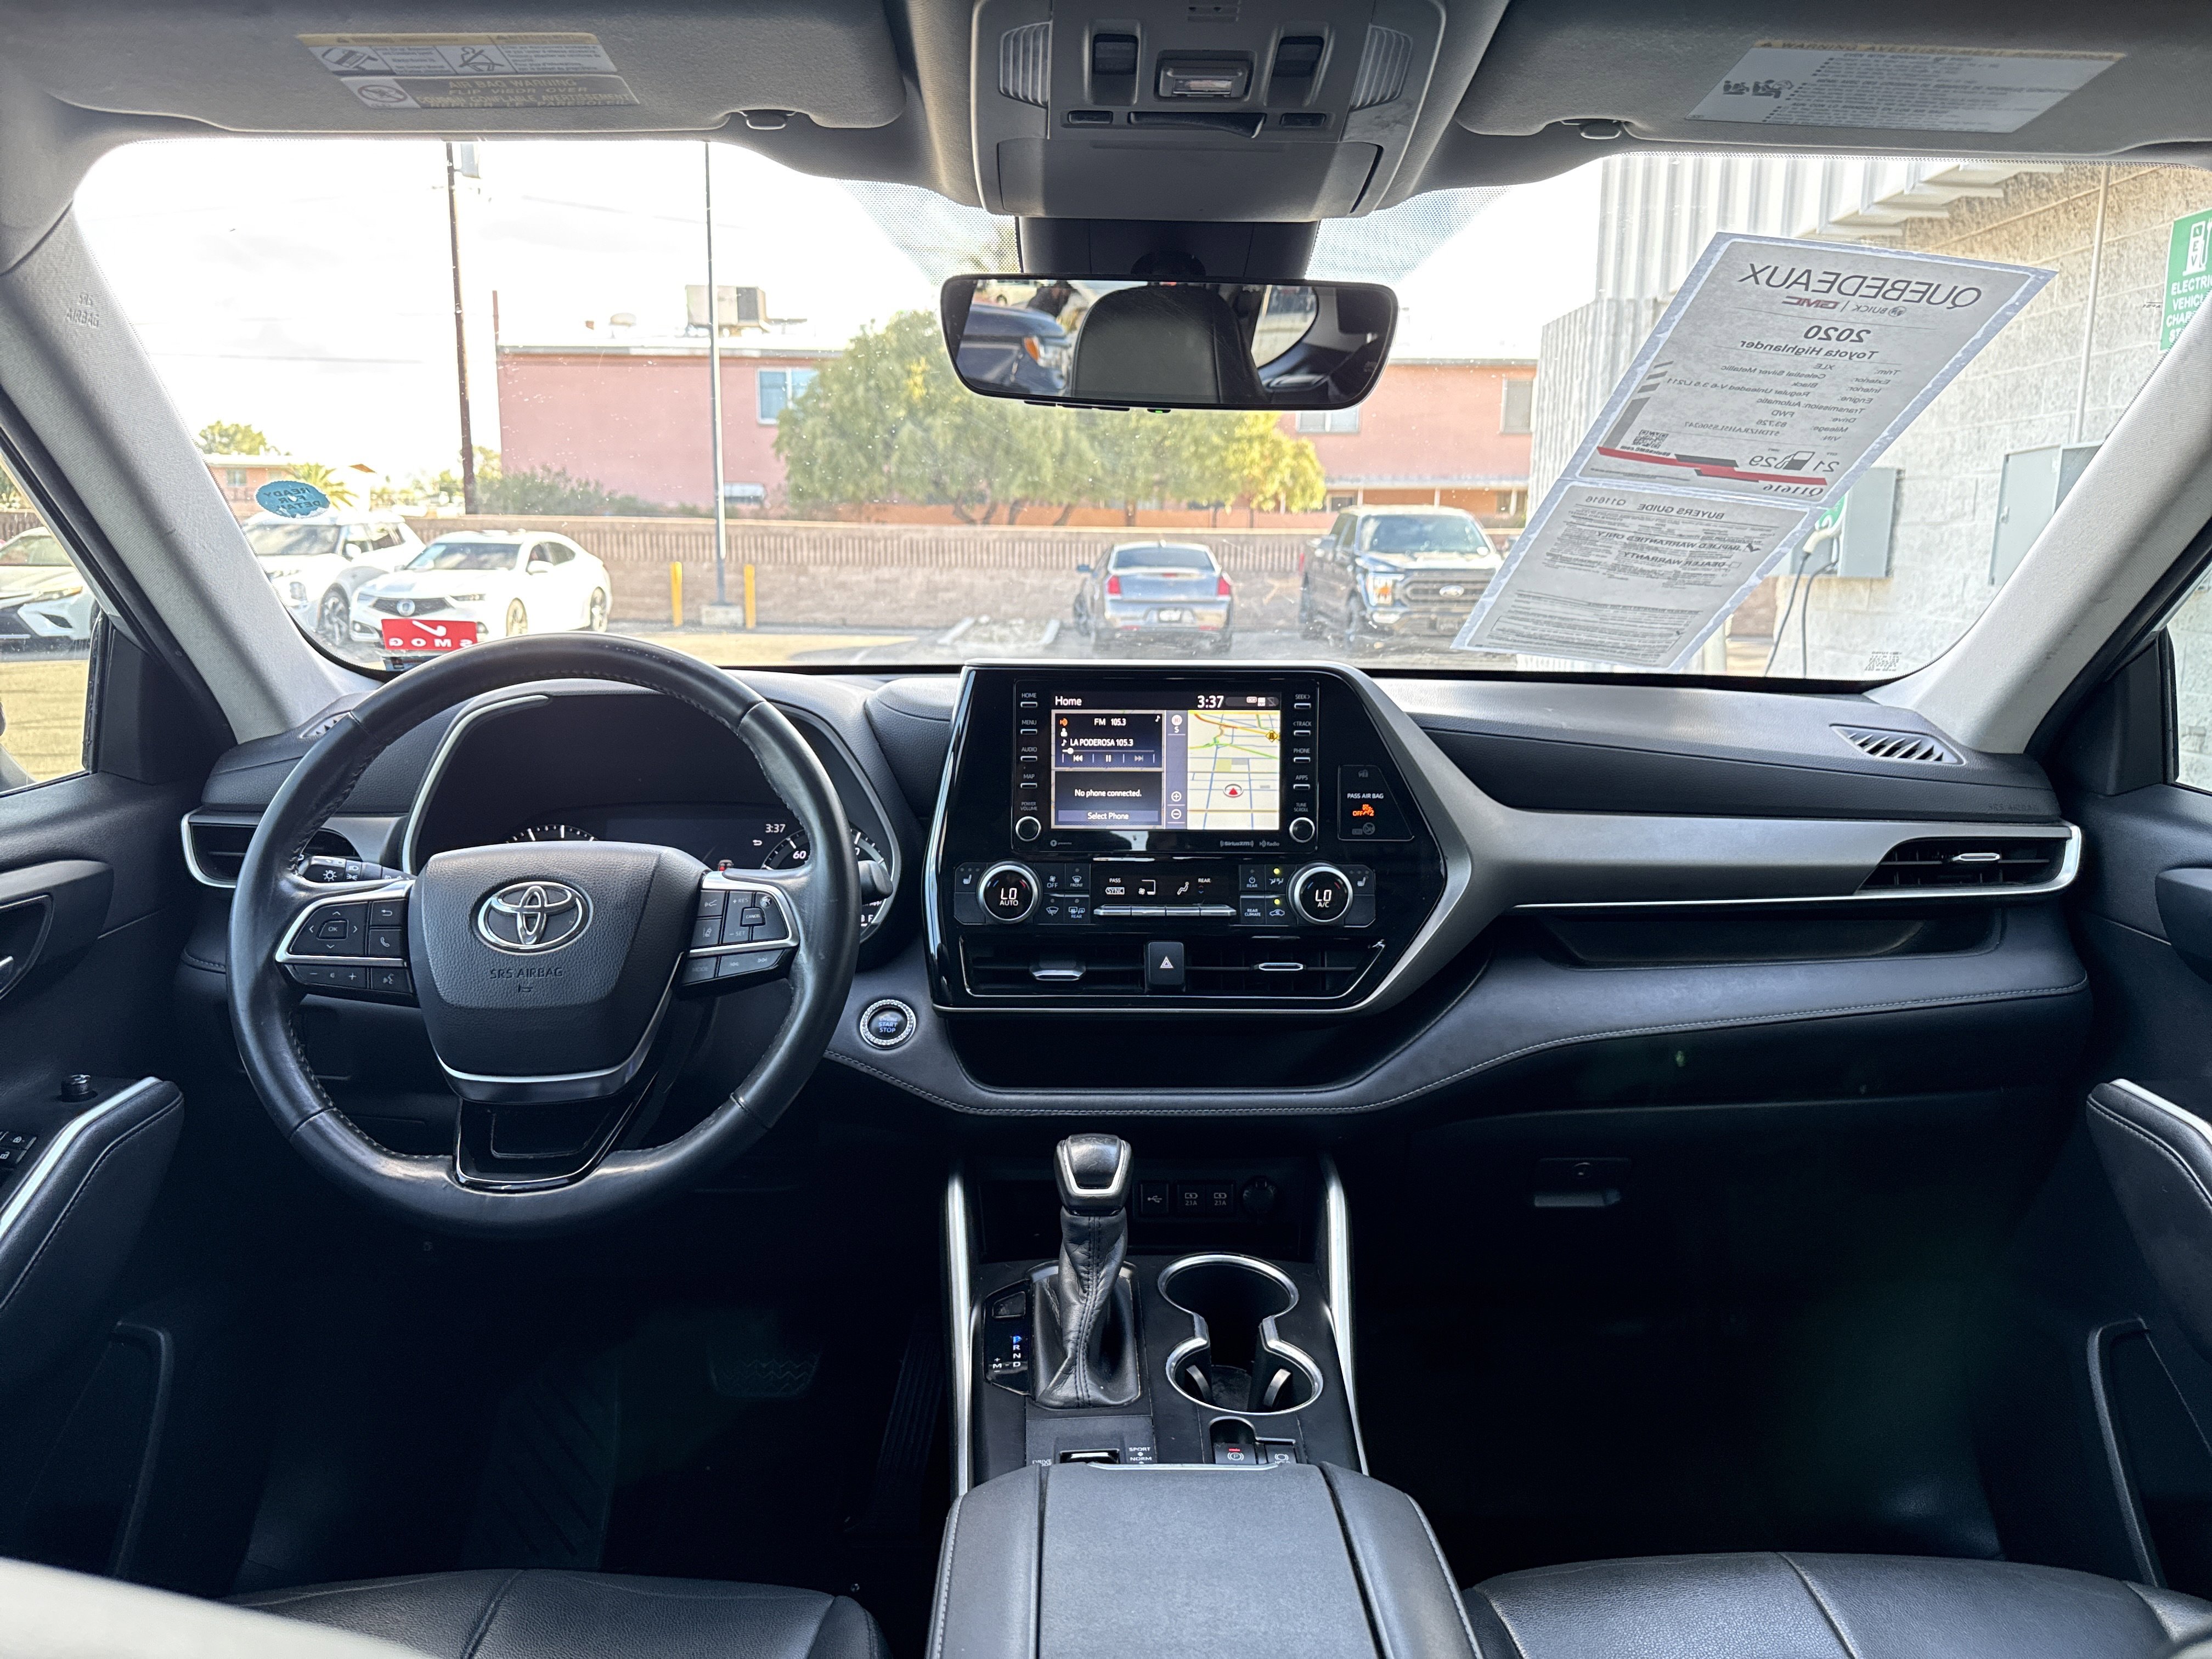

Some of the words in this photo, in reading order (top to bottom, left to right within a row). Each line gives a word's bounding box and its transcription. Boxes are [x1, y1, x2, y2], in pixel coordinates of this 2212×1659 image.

[449, 81, 470, 89] AIR
[475, 80, 507, 88] BAG
[511, 79, 577, 87] WARNING
[77, 294, 93, 306] SRS
[2172, 293, 2203, 311] VEHIC
[66, 308, 99, 328] AIRBAG
[1055, 696, 1082, 706] Home
[1197, 695, 1224, 708] 3:37
[1116, 738, 1133, 747] 105.3
[1086, 789, 1106, 798] phone
[1107, 789, 1142, 797] connected.
[765, 823, 786, 833] 3:37
[793, 850, 806, 859] 60
[490, 969, 514, 979] SRS
[516, 967, 563, 978] AIRBAG
[1013, 1336, 1022, 1344] P
